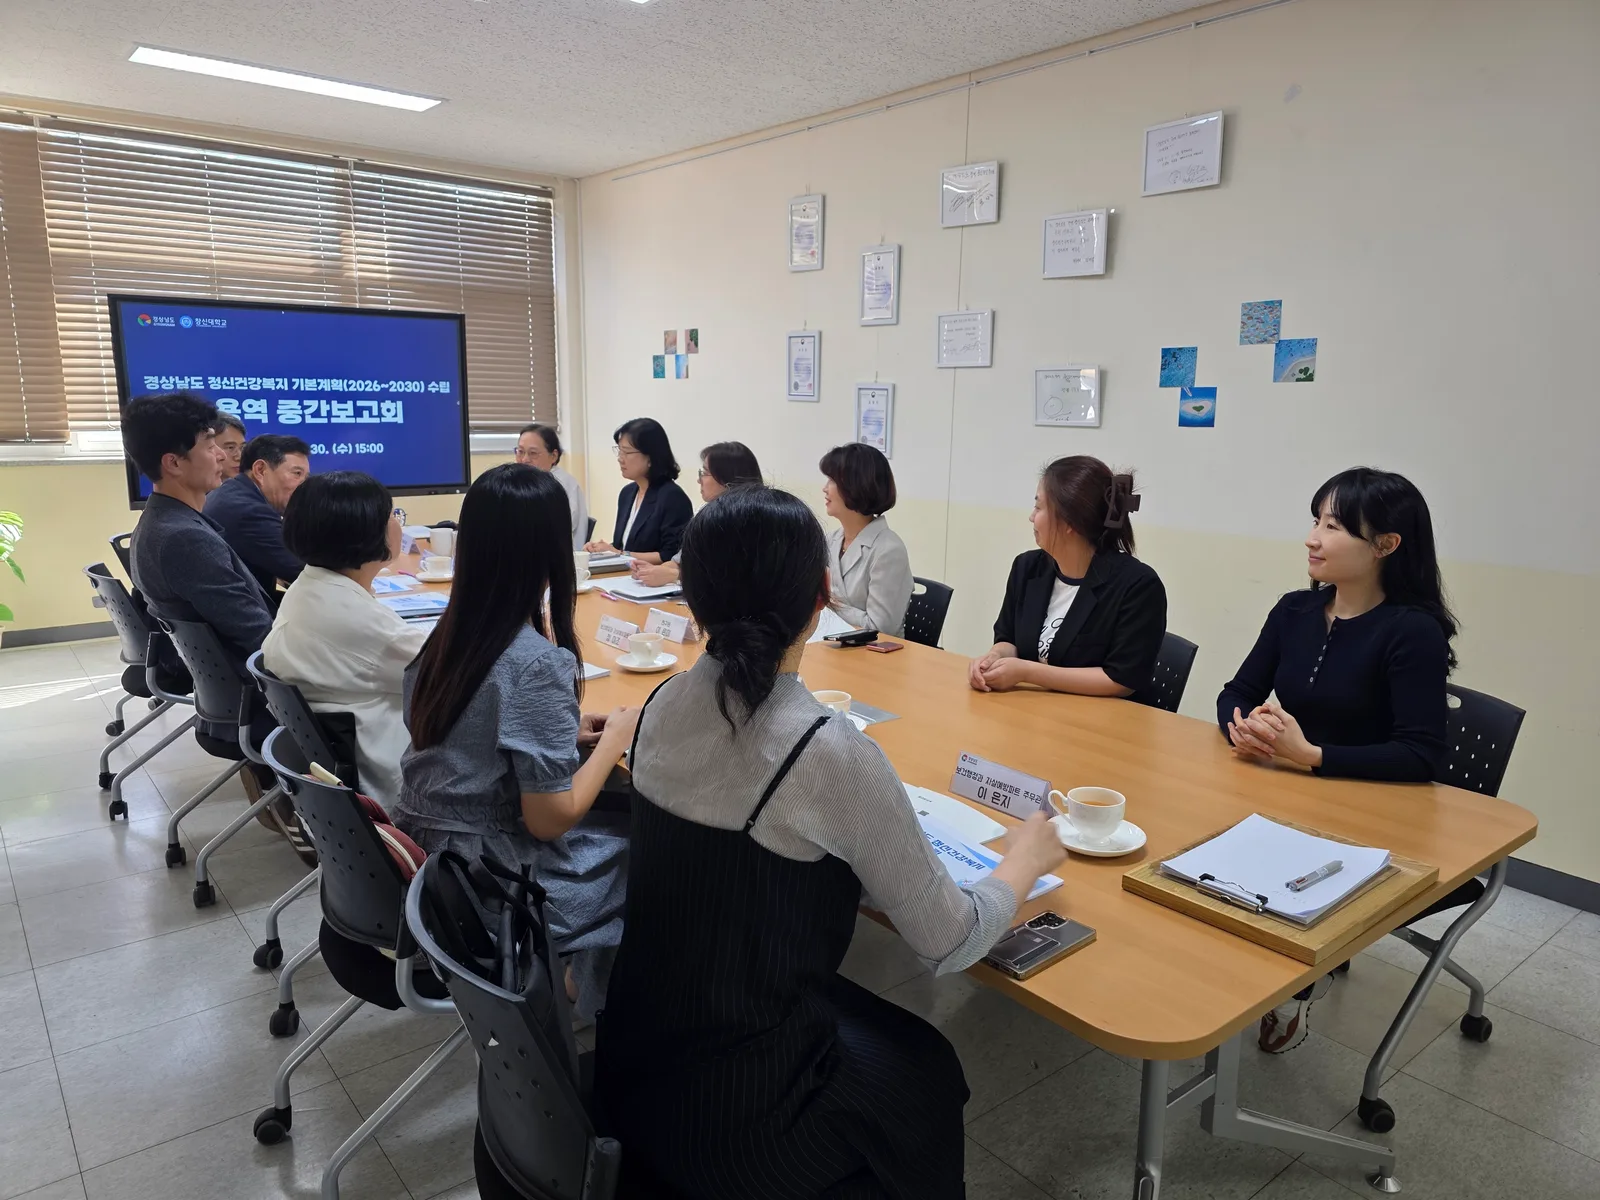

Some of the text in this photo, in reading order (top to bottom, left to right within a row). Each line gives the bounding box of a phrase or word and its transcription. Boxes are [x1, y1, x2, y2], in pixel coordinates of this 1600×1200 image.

[195, 317, 227, 326] 창신대학교
[144, 376, 450, 393] 경상남도 정신건강복지 기본계획(2026~2030) 수립
[277, 399, 404, 424] 중간보고회
[310, 443, 384, 455] 30. (수) 15:00
[956, 766, 1042, 805] 보건행정과 자살예방파트 주무관
[977, 786, 1011, 809] 이 은지
